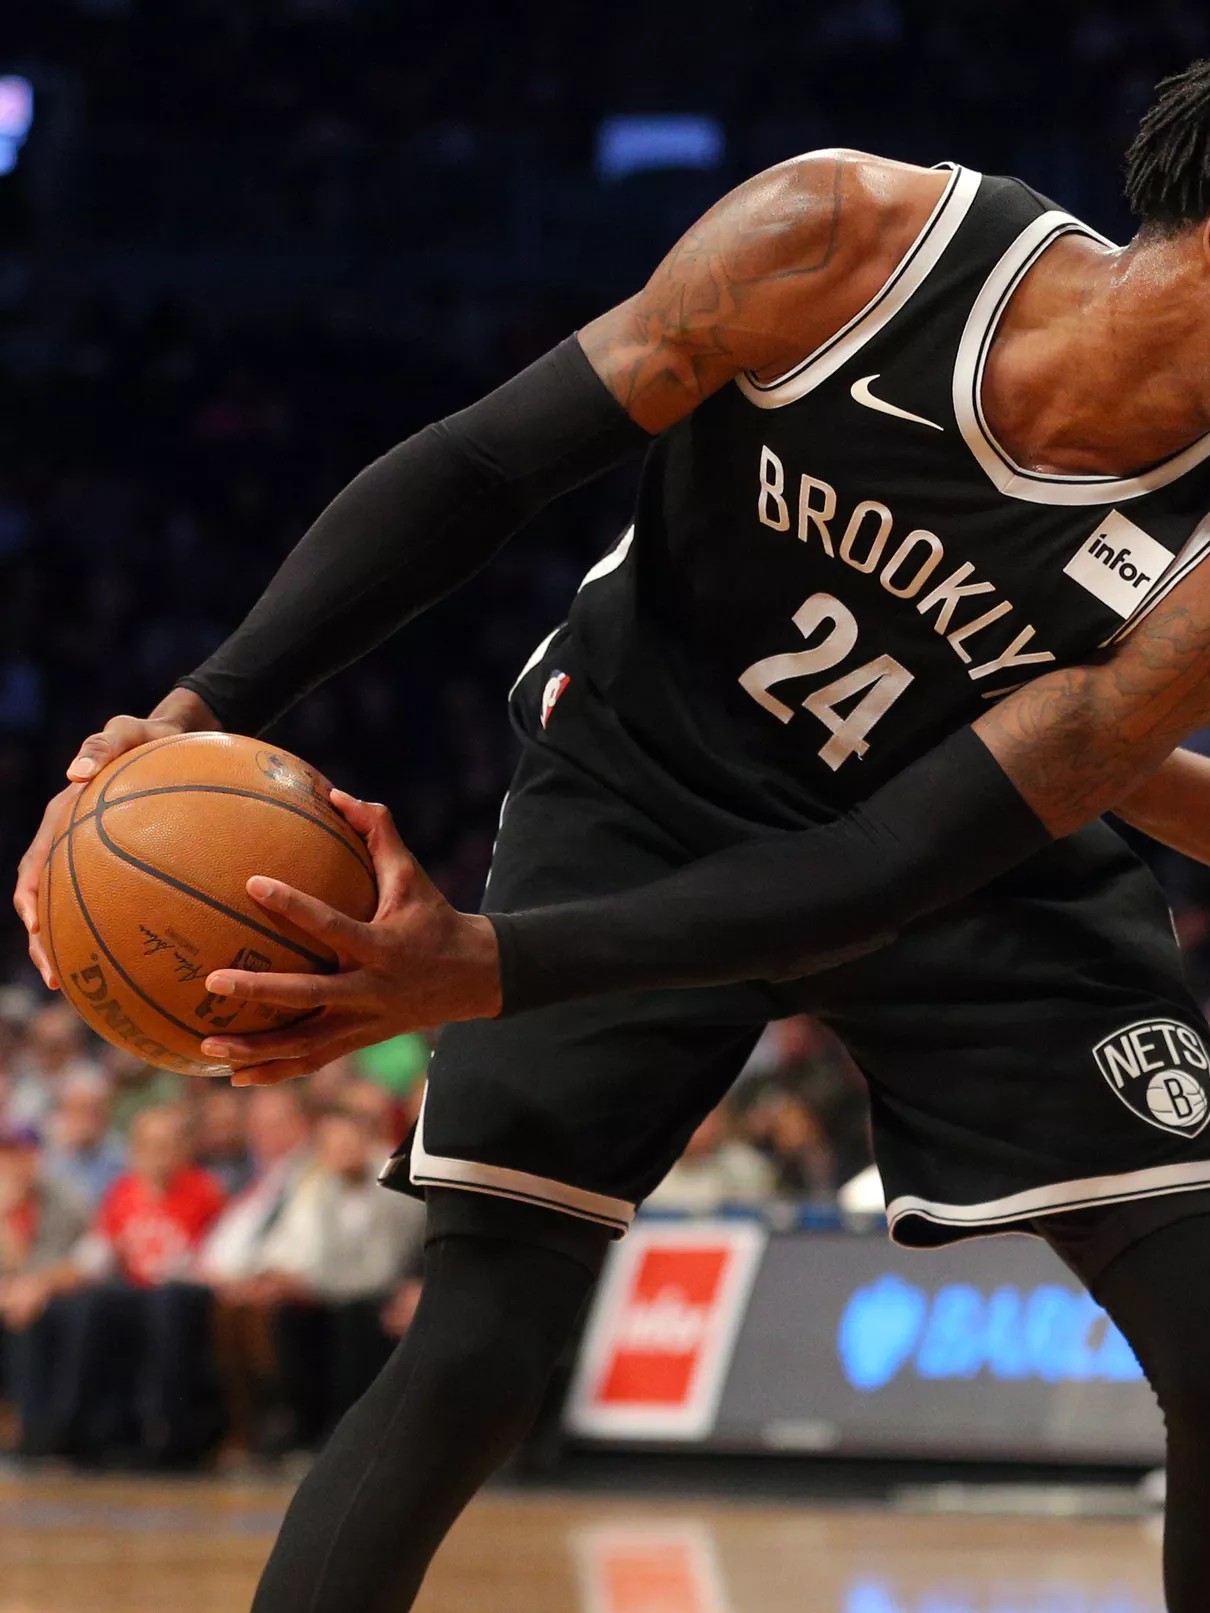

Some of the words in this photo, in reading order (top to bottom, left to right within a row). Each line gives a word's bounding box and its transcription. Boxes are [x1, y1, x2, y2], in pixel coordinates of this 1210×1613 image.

[758, 445, 1056, 699] BROOKLY
[1088, 534, 1151, 588] infor
[738, 592, 915, 772] 24
[70, 963, 195, 1069] LDING
[1103, 1024, 1208, 1089] NETS
[1163, 1077, 1193, 1120] B
